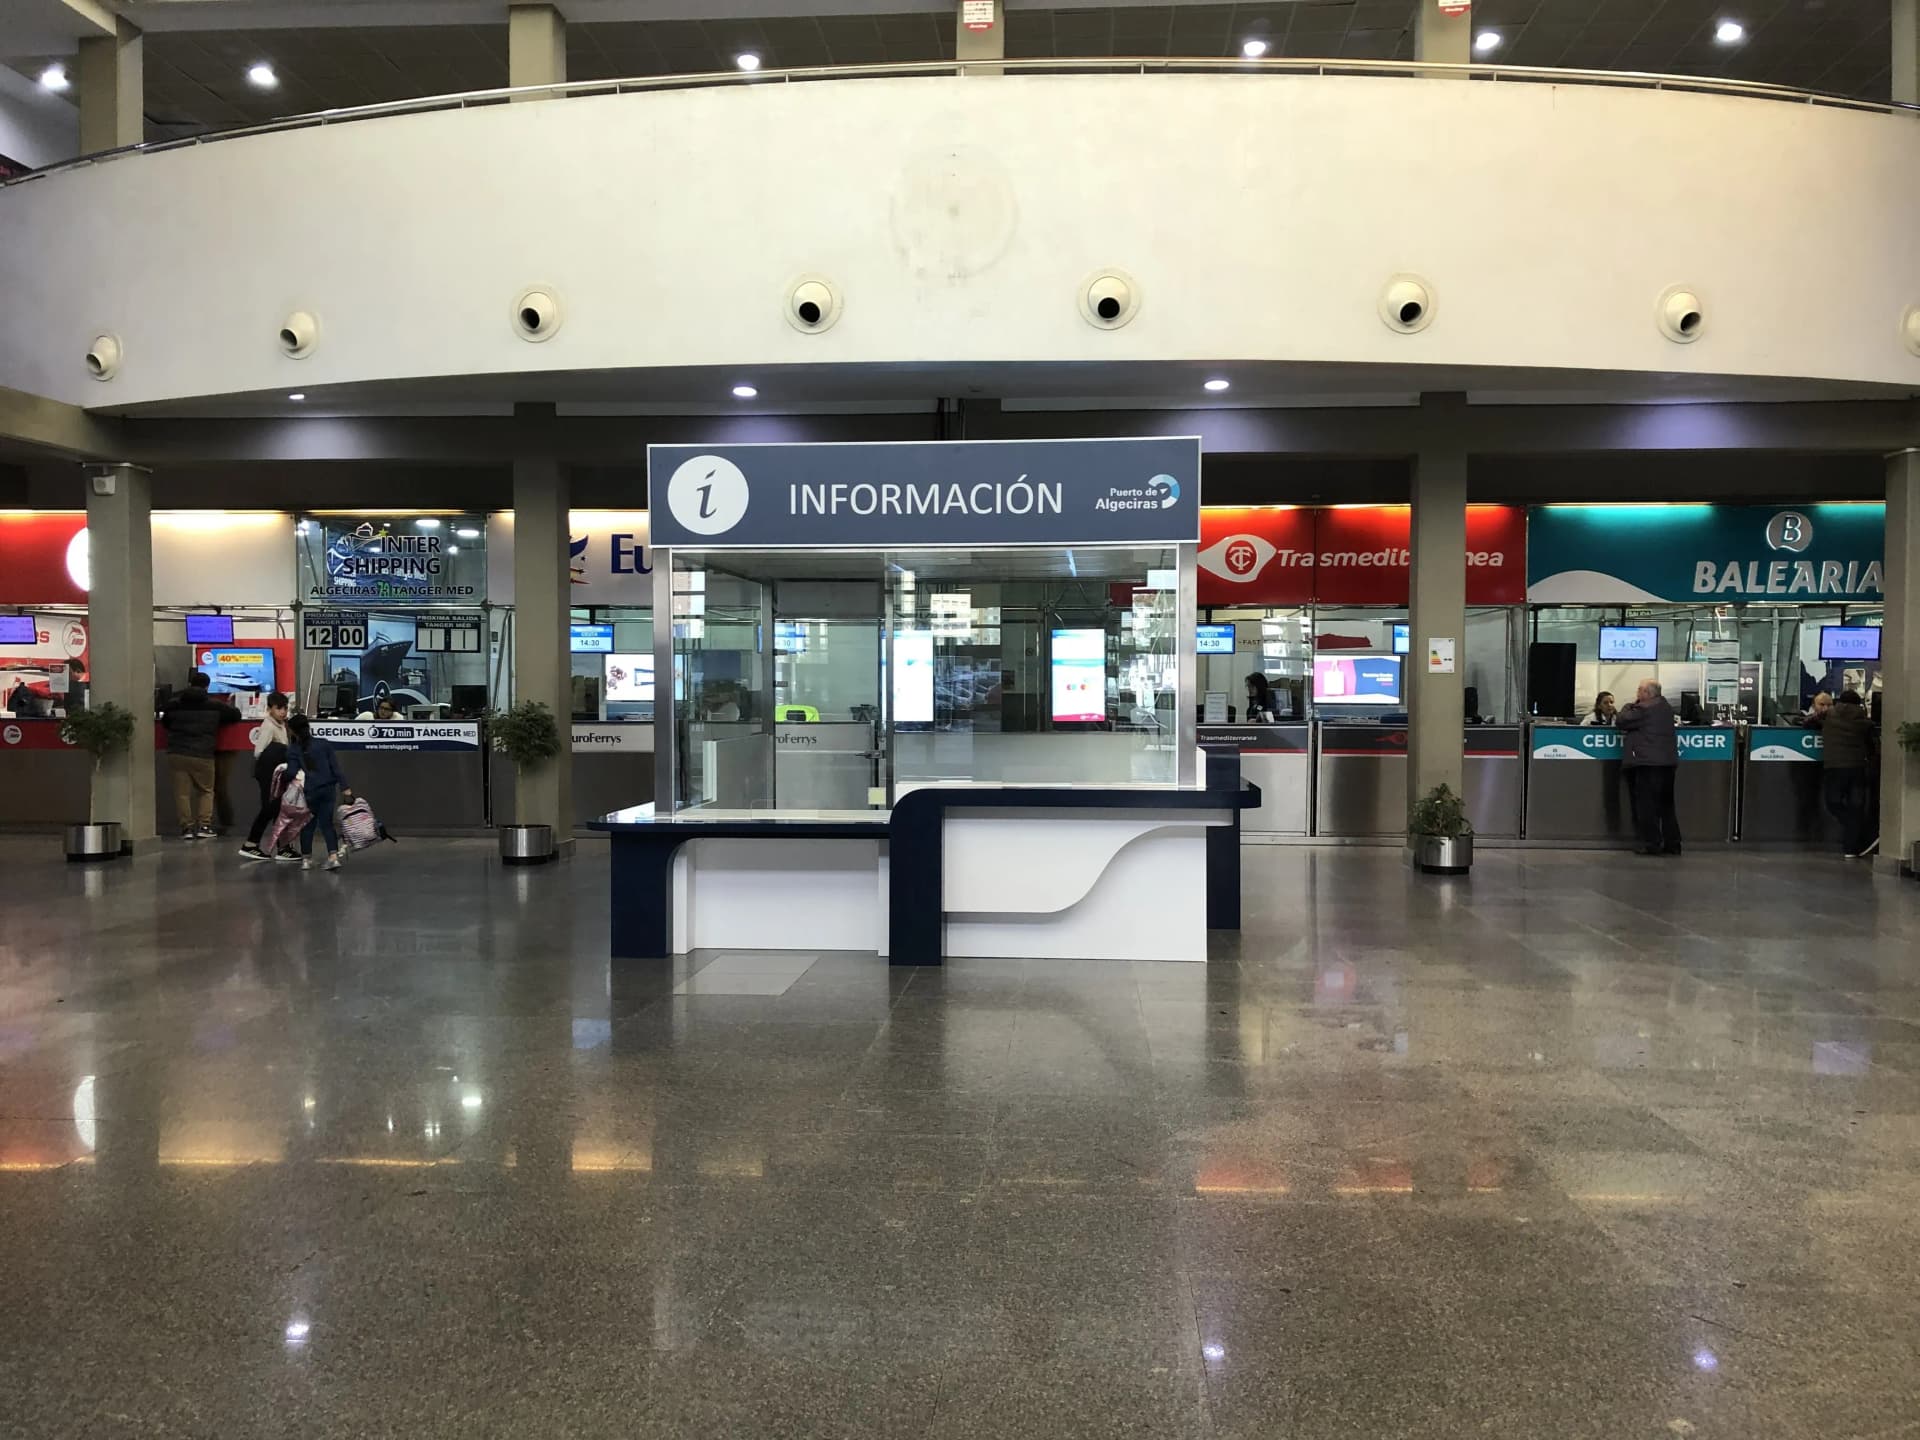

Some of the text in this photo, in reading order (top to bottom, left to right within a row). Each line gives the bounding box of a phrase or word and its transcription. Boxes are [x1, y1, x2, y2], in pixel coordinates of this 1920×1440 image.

[790, 474, 1062, 515] INFORMACIÓN
[1110, 487, 1158, 497] Puerto de
[1095, 498, 1158, 512] Algeciras
[380, 536, 441, 553] INTER
[343, 557, 441, 575] SHIPPING
[310, 585, 377, 596] ALGECIRAS
[393, 585, 442, 596] TANGER
[446, 585, 474, 596] MED
[1611, 639, 1646, 649] 14:00
[310, 727, 365, 738] LGECIRAS
[381, 728, 394, 738] 70
[396, 728, 412, 738] min
[571, 733, 622, 746] uroFerrys
[1582, 734, 1726, 748] CEUT NGER
[365, 743, 419, 751] www.intershipping.es
